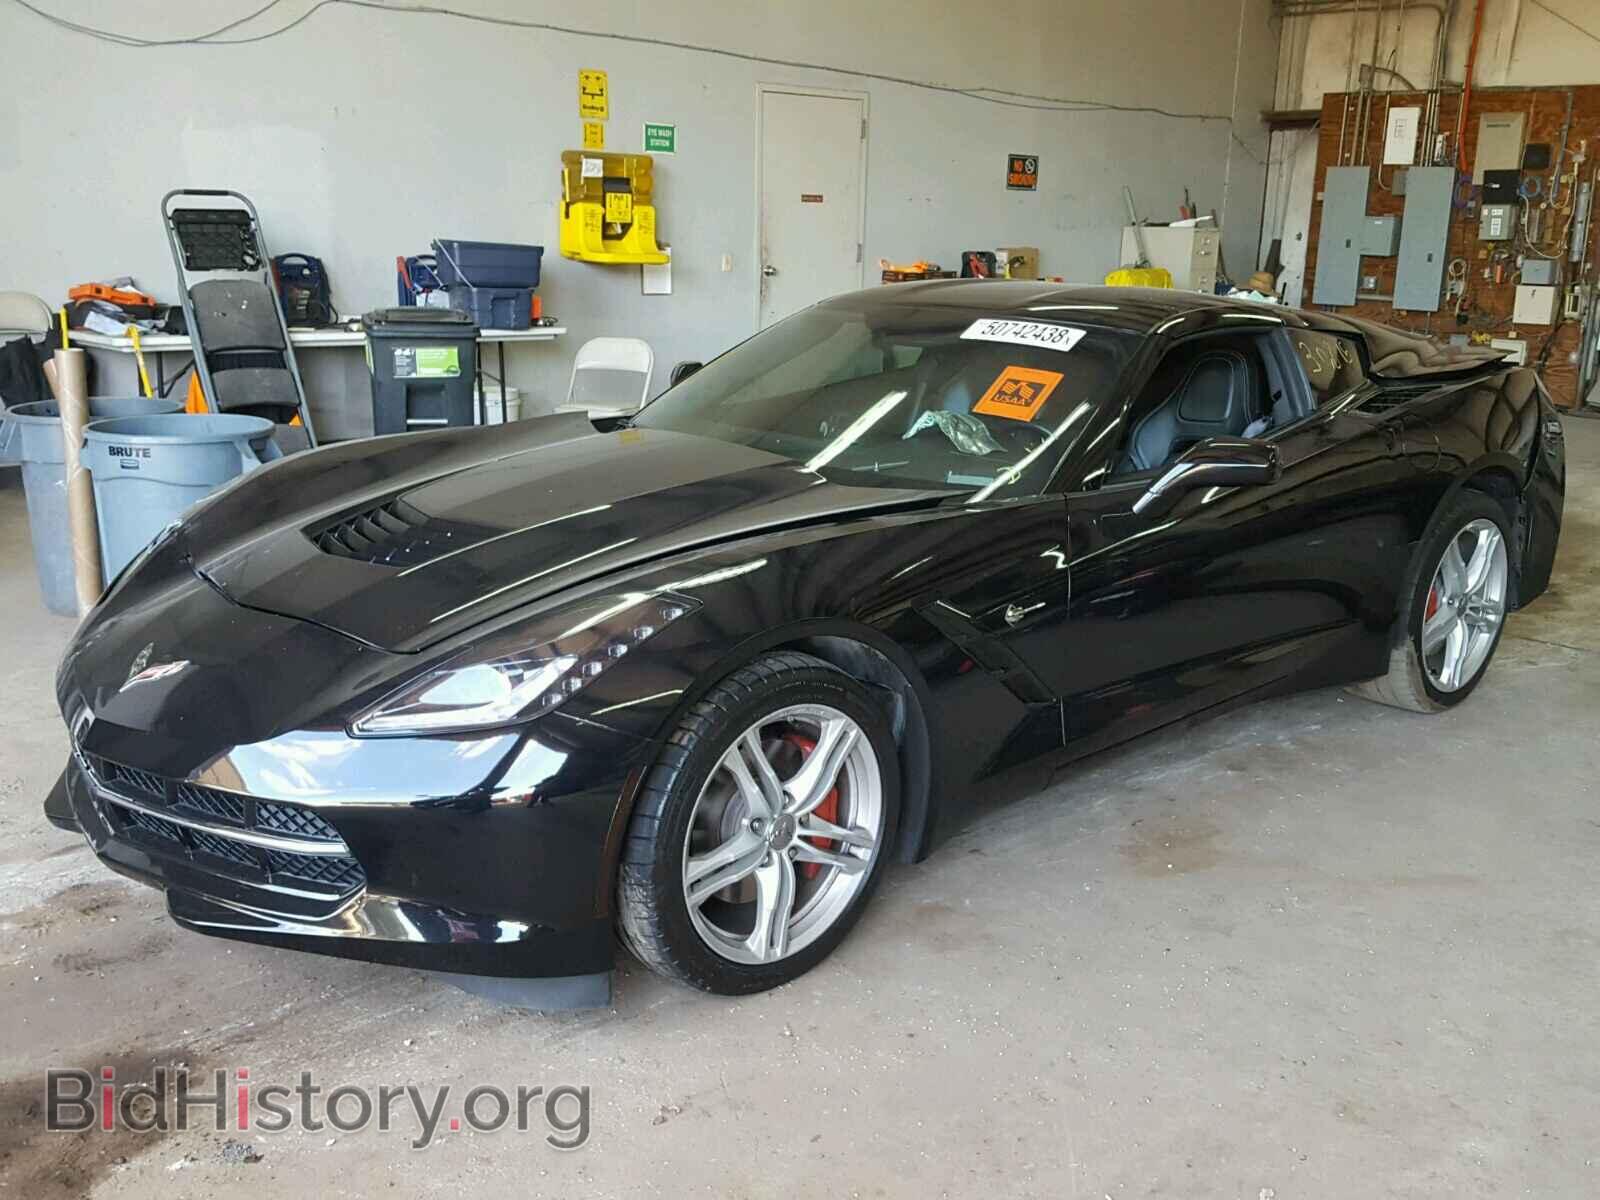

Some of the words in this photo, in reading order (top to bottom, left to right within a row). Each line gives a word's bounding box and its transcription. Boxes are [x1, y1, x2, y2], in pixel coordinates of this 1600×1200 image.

[981, 321, 1069, 344] 50742438
[993, 393, 1027, 406] USAA
[108, 445, 151, 458] BRUTE
